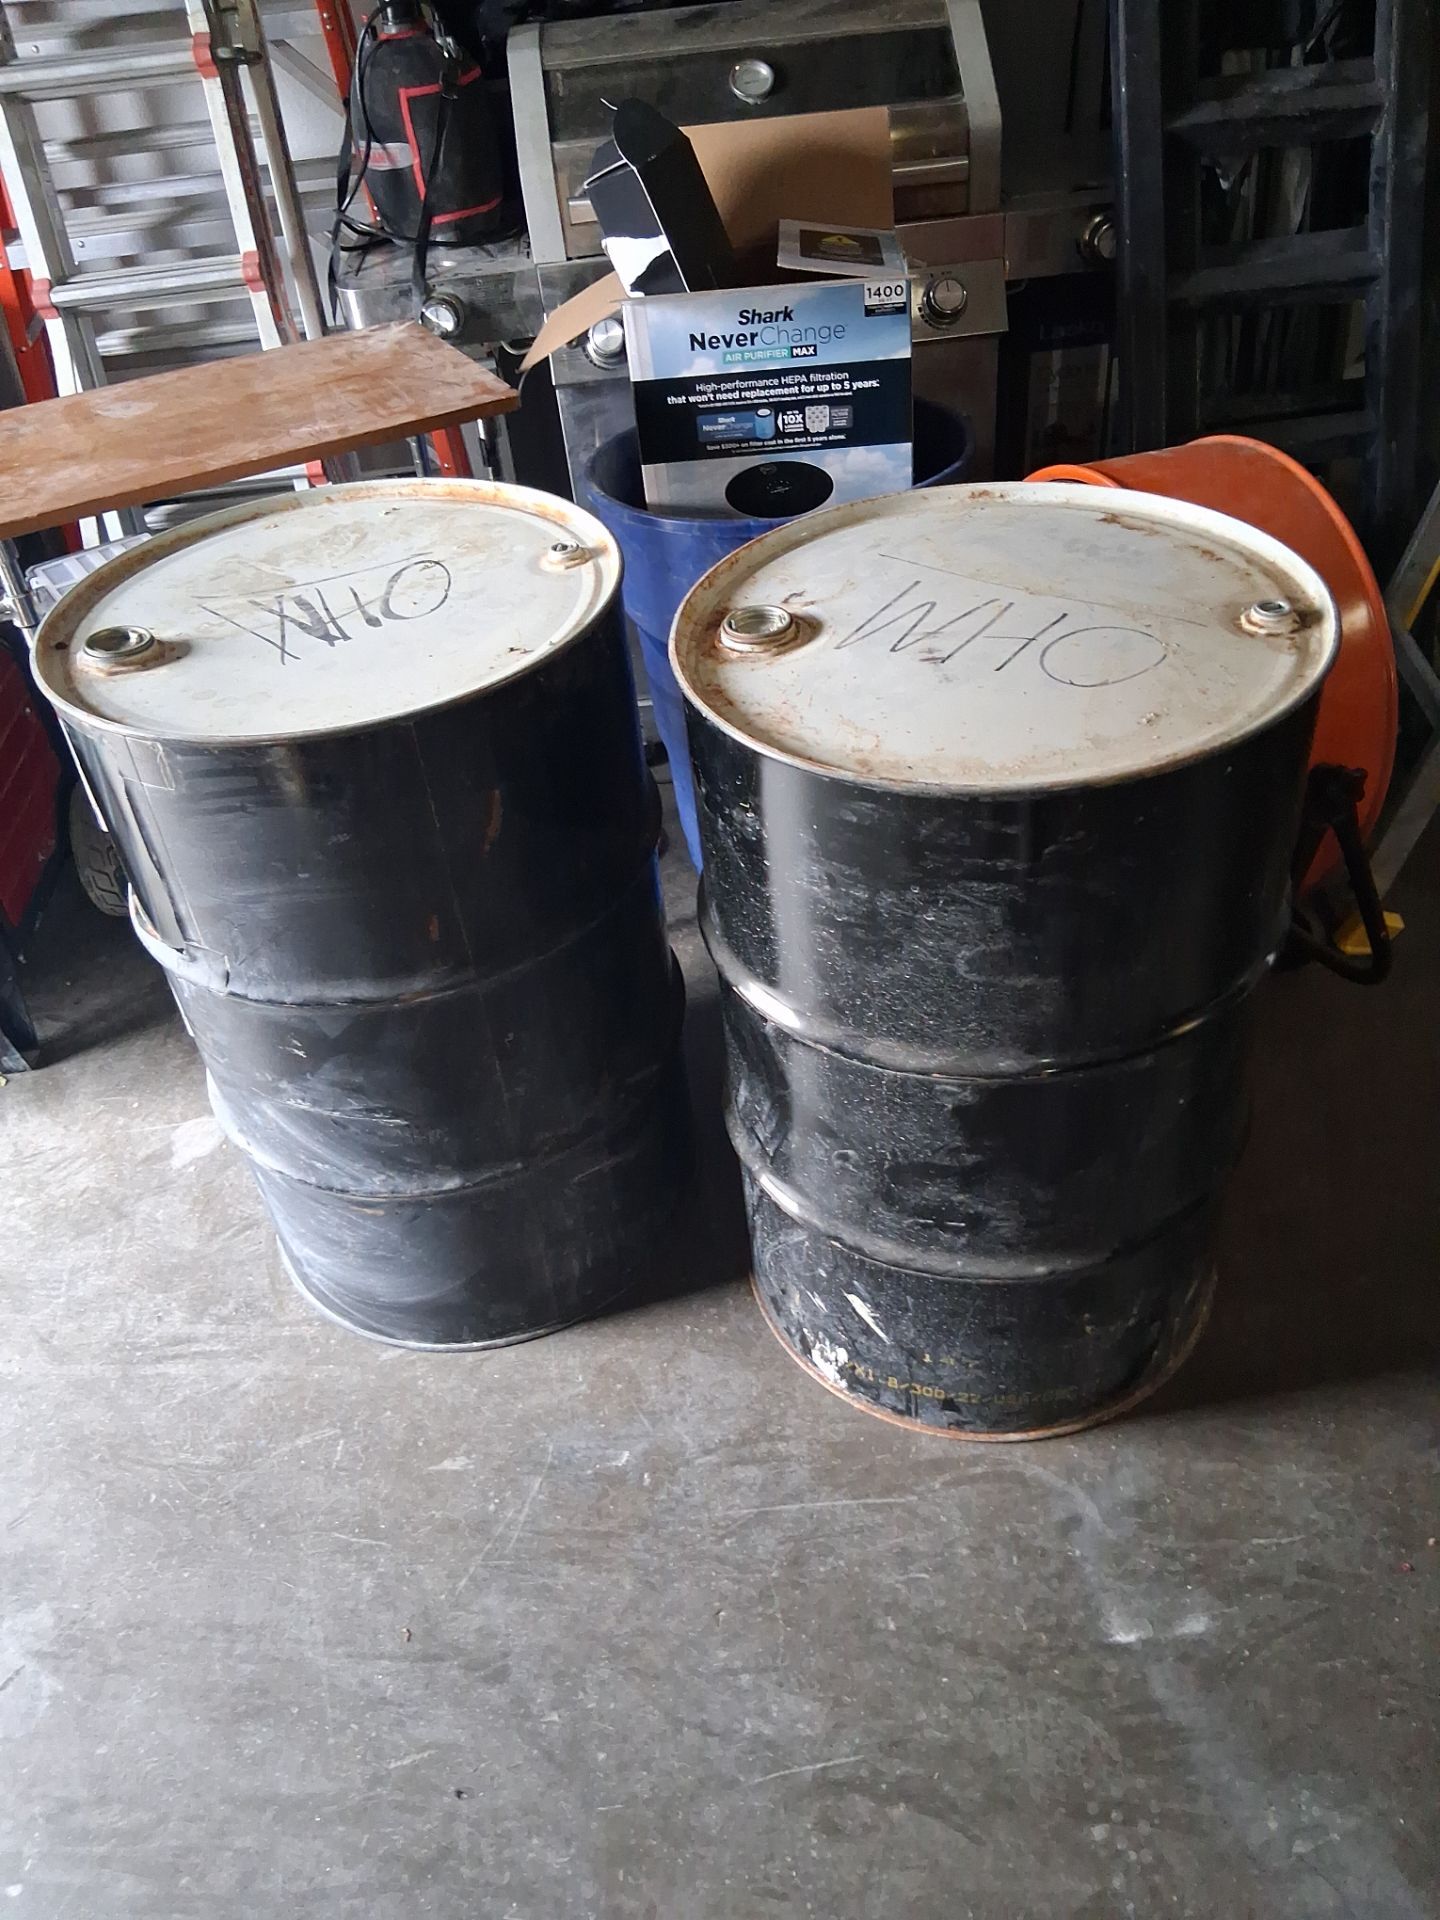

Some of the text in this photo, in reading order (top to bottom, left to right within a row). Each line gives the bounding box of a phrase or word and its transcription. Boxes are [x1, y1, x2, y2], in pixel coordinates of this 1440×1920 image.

[866, 284, 904, 299] 1400
[738, 306, 794, 325] Shark
[725, 345, 816, 362] AIR PURIFIER MAX
[696, 372, 849, 393] High-performance HEPA filtration
[667, 395, 687, 405] that
[688, 393, 715, 403] won't
[716, 390, 740, 400] need
[741, 386, 799, 398] replacement
[801, 384, 815, 393] for
[816, 384, 830, 393] up
[831, 382, 842, 391] to
[843, 380, 851, 389] 5
[783, 413, 804, 424] 10X
